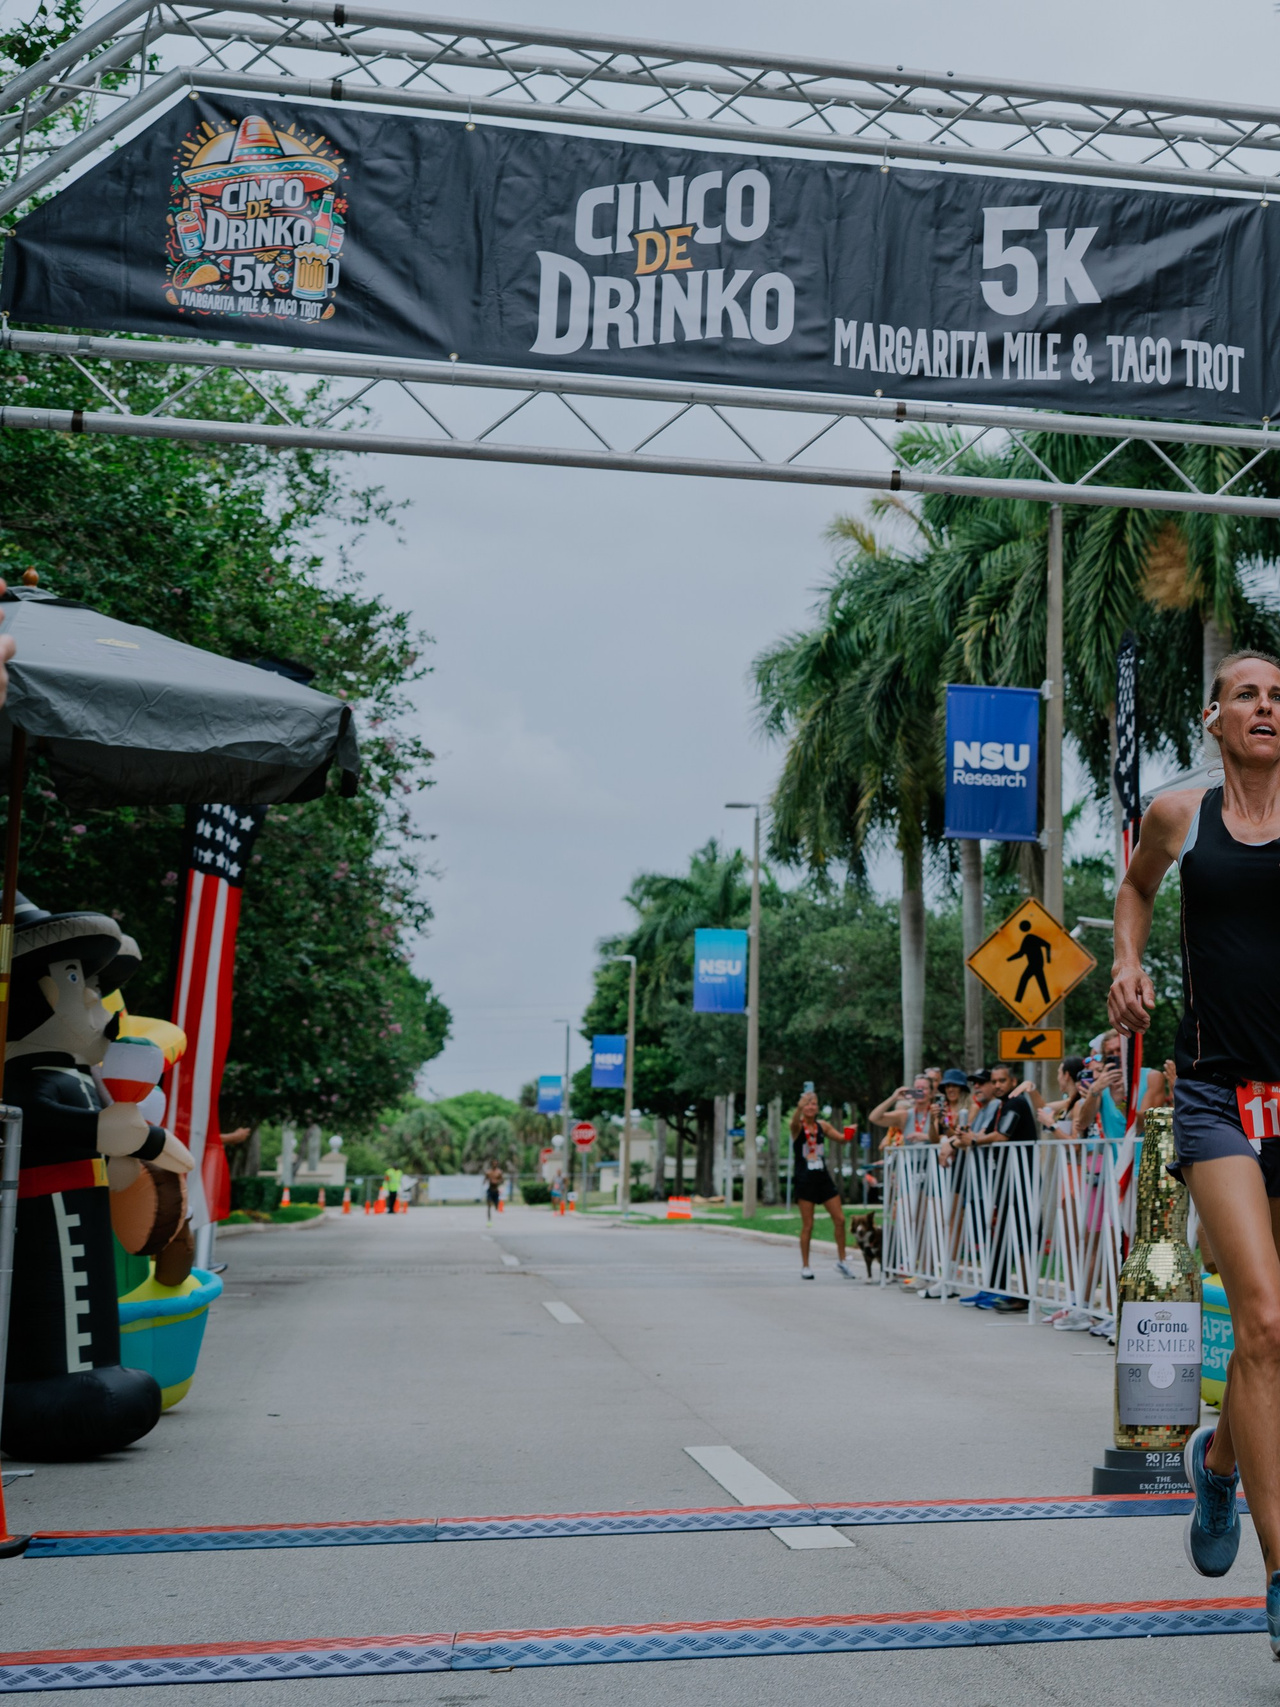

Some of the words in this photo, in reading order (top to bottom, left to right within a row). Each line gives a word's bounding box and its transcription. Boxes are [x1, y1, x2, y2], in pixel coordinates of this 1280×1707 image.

[221, 178, 304, 212] CINCO
[246, 198, 270, 220] DE
[574, 169, 770, 256] CINCO
[201, 209, 312, 251] DRINKO
[634, 226, 694, 275] DE
[980, 205, 1102, 316] 5K
[232, 256, 275, 292] 5K
[181, 290, 234, 312] MARGARITA
[237, 296, 259, 313] MILE
[260, 299, 270, 314] &
[274, 298, 297, 316] TACO
[300, 301, 323, 319] TROT
[529, 251, 795, 355] DRINKO
[833, 317, 992, 380] MARGARITA
[1002, 332, 1061, 380] MILE
[1070, 333, 1095, 384] &
[1106, 335, 1172, 385] TACO
[1181, 339, 1245, 394] TROT
[953, 741, 1030, 771] NSU
[953, 769, 1027, 788] Research
[699, 959, 742, 976] NSU
[1137, 1318, 1188, 1337] Corona
[1127, 1339, 1195, 1352] PREMIER
[1128, 1368, 1141, 1378] 90
[1145, 1453, 1160, 1463] 90
[1165, 1453, 1181, 1463] 2.6
